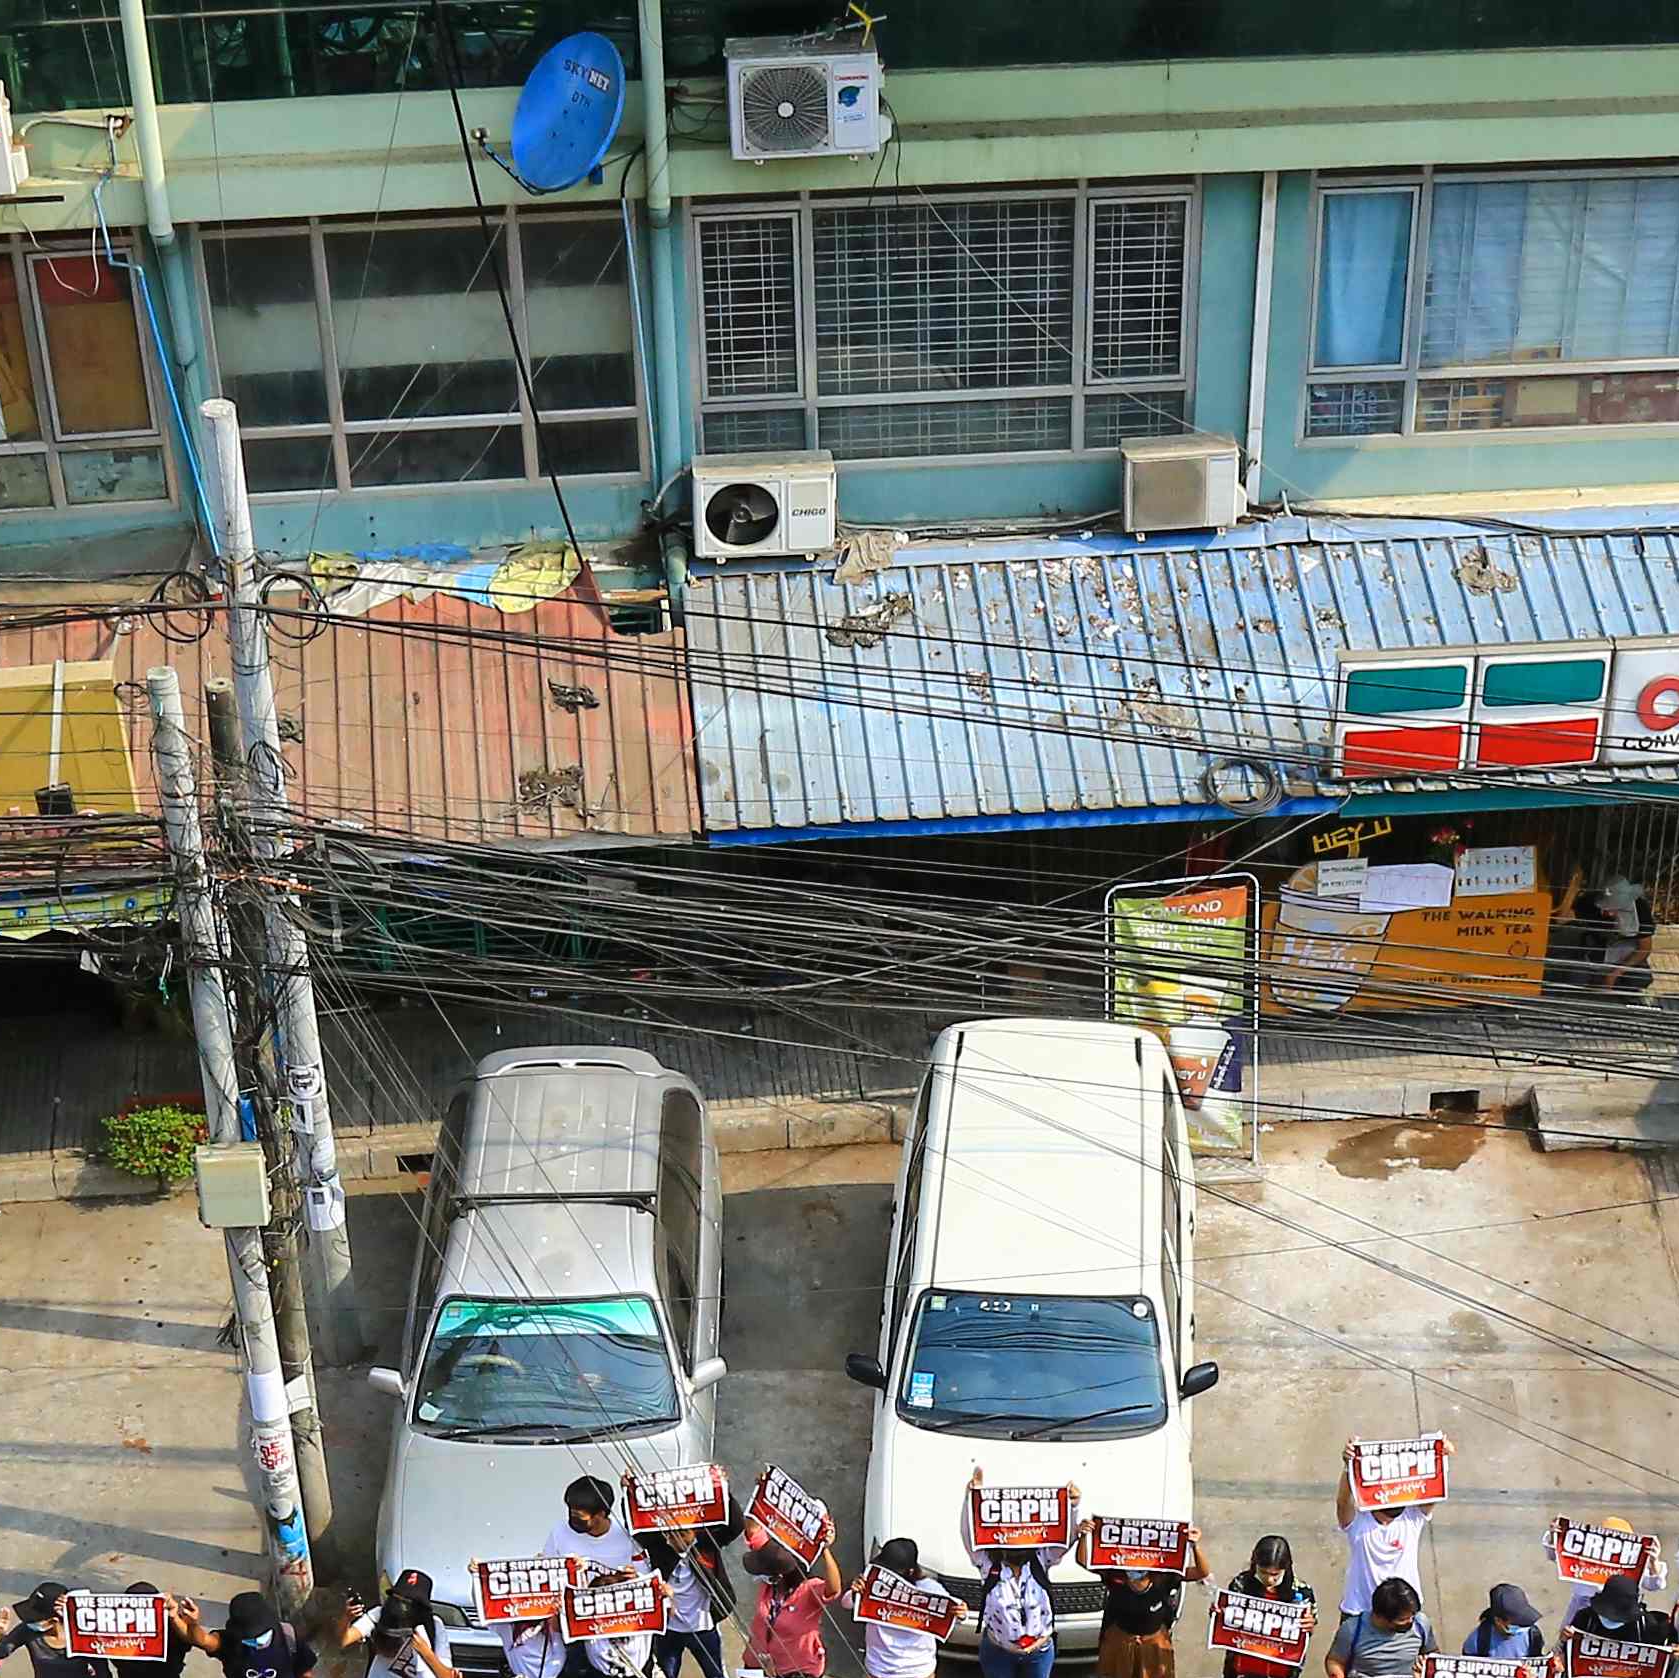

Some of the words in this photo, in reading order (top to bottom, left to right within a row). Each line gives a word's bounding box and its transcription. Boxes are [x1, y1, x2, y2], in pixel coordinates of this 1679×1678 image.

[1312, 823, 1364, 853] HEY
[1188, 900, 1222, 914] AND
[1421, 911, 1452, 922] THE
[1457, 907, 1536, 922] WALKING
[1456, 926, 1495, 937] MILK
[1504, 924, 1534, 936] TEA
[1362, 1445, 1381, 1456] WE
[1386, 1441, 1435, 1454] SUPPORT
[1362, 1452, 1437, 1482] CRPH
[635, 1478, 714, 1508] CRPH
[981, 1488, 1000, 1499] WE
[1003, 1488, 1058, 1500] SUPPORT
[764, 1482, 821, 1541] CRPH
[981, 1500, 1059, 1524] CRPH
[1101, 1526, 1178, 1549] CRPH
[1564, 1530, 1643, 1566] CRPH
[488, 1561, 507, 1571] WE
[512, 1559, 566, 1569] SUPPORT
[488, 1568, 567, 1595] CRPH
[75, 1596, 95, 1607] WE
[99, 1597, 155, 1608] SUPPORT
[575, 1588, 654, 1616] CRPH
[872, 1580, 949, 1612] CRPH
[76, 1606, 155, 1632] CRPH
[1225, 1605, 1299, 1643] CRPH
[1581, 1640, 1659, 1662] CRPH
[1436, 1659, 1454, 1672] WE
[1458, 1661, 1517, 1676] SUPPORT
